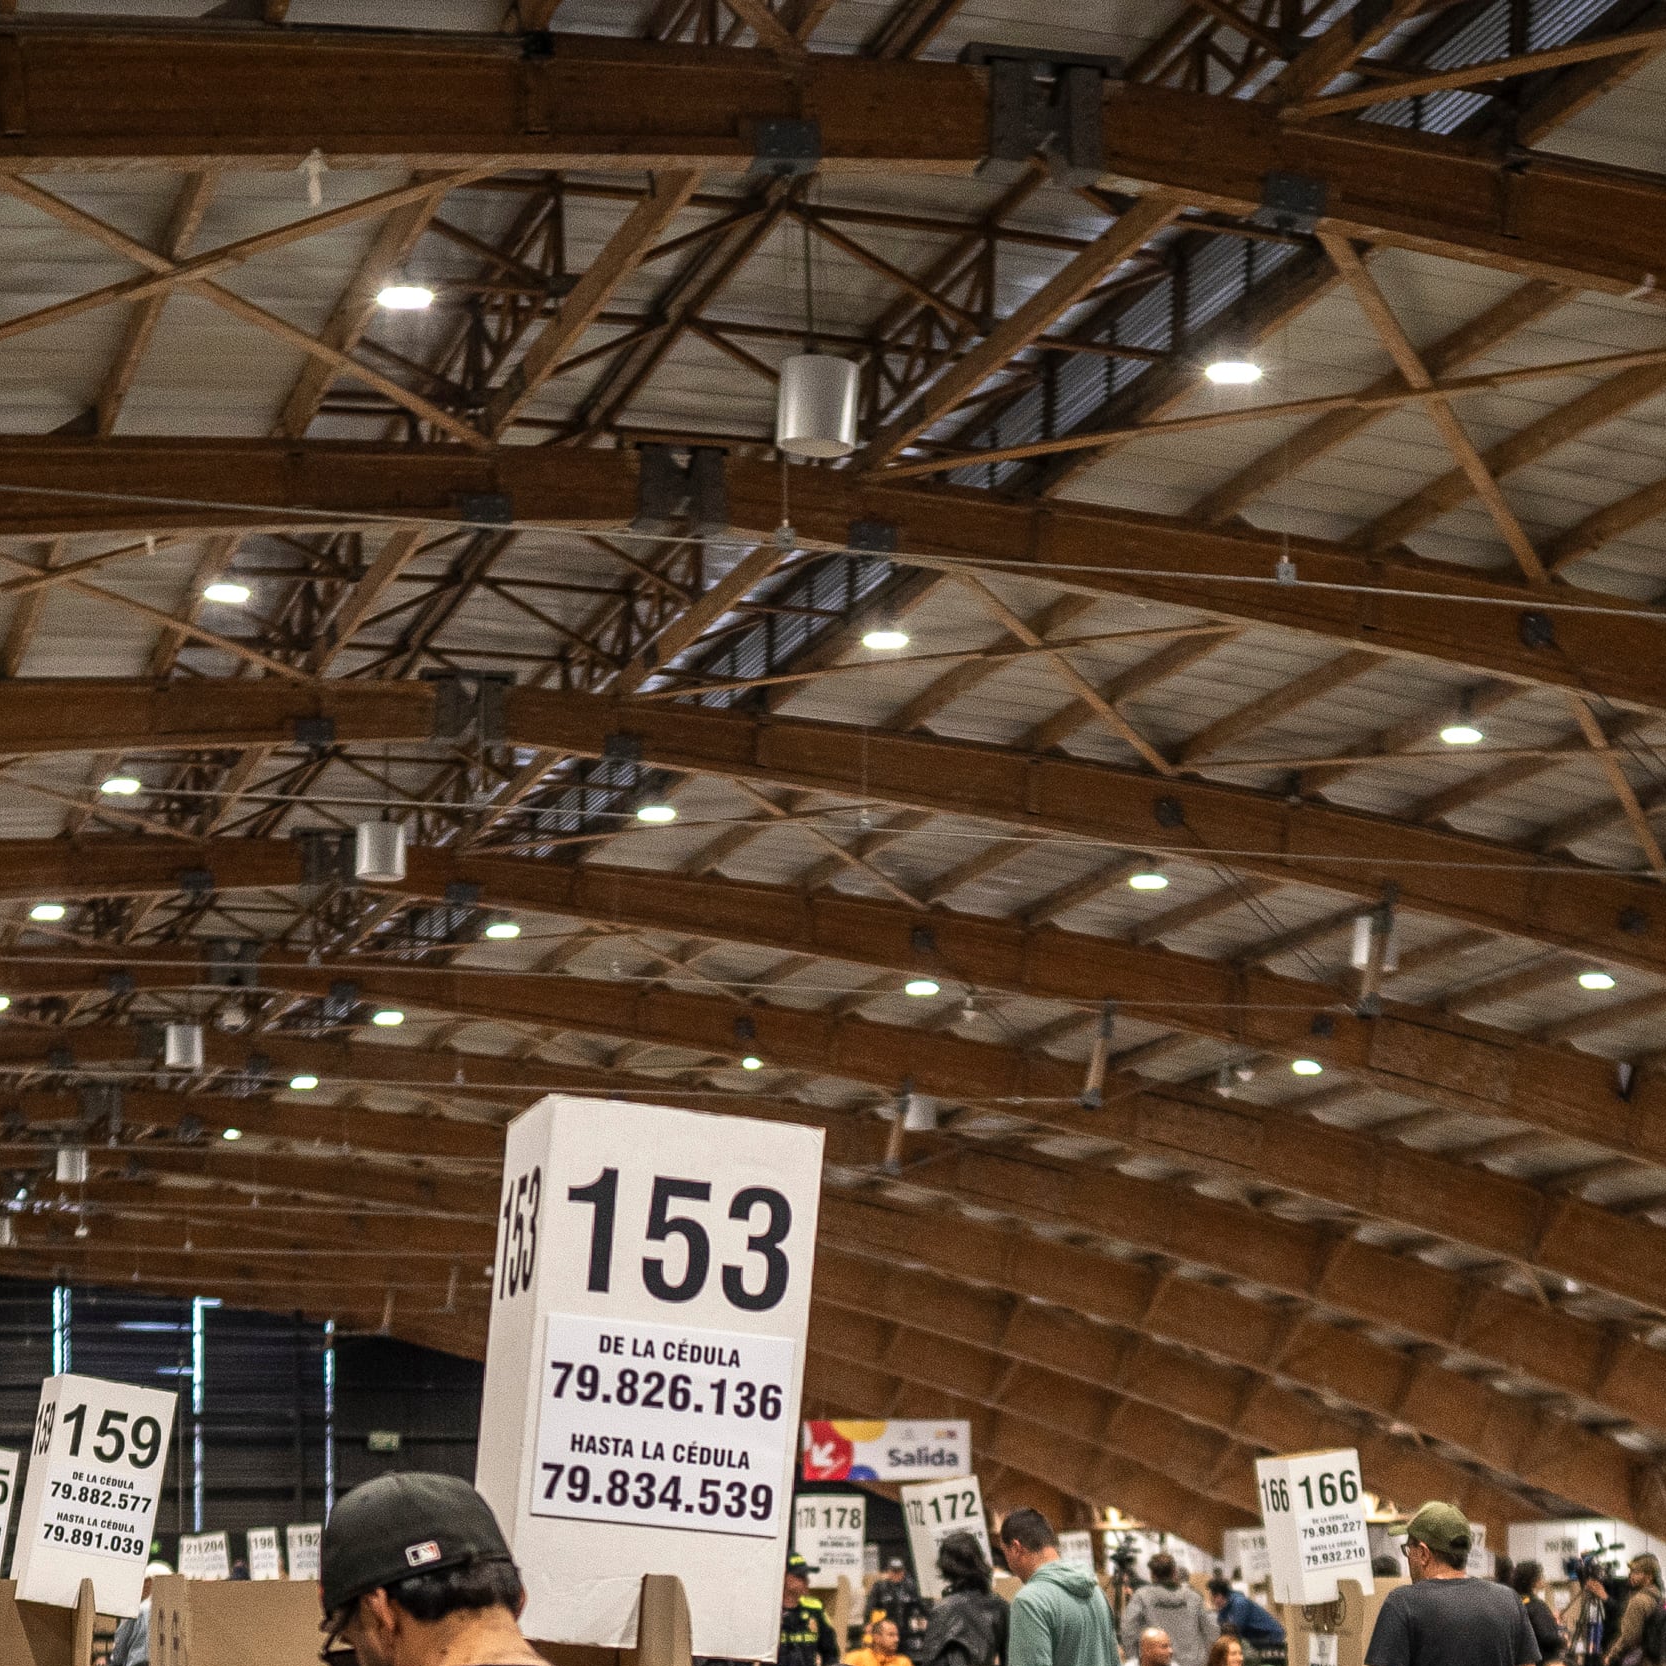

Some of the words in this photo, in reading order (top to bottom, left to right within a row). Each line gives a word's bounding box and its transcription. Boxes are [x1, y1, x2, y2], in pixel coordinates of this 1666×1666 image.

[499, 1165, 540, 1300] 153
[568, 1167, 792, 1312] 153
[599, 1334, 624, 1355] DE
[633, 1338, 655, 1359] LA
[663, 1338, 740, 1368] CÉDULA
[551, 1360, 783, 1421] 79.826.136
[34, 1401, 56, 1456] 159
[63, 1403, 162, 1469] 159
[570, 1433, 633, 1457] HASTA
[642, 1441, 664, 1461] LA
[673, 1441, 750, 1469] CÉDULA
[888, 1448, 959, 1467] Salida
[51, 1481, 151, 1513] 79.882.577
[72, 1471, 83, 1481] DE
[87, 1474, 97, 1484] LA
[100, 1475, 134, 1490] CÉDULA
[542, 1462, 773, 1521] 79.834.539
[1261, 1478, 1290, 1513] 166
[1298, 1469, 1358, 1509] 166
[57, 1512, 84, 1524] HASTA
[87, 1517, 97, 1527] LA
[101, 1519, 134, 1534] CÉDULA
[797, 1507, 816, 1529] 178
[822, 1507, 861, 1530] 178
[907, 1500, 926, 1526] 172
[929, 1490, 978, 1524] 172
[43, 1523, 144, 1556] 79.891.039
[253, 1537, 274, 1549] 198
[298, 1533, 320, 1547] 192
[1302, 1521, 1362, 1539] 79.930.227
[1305, 1547, 1365, 1566] 79.932.210
